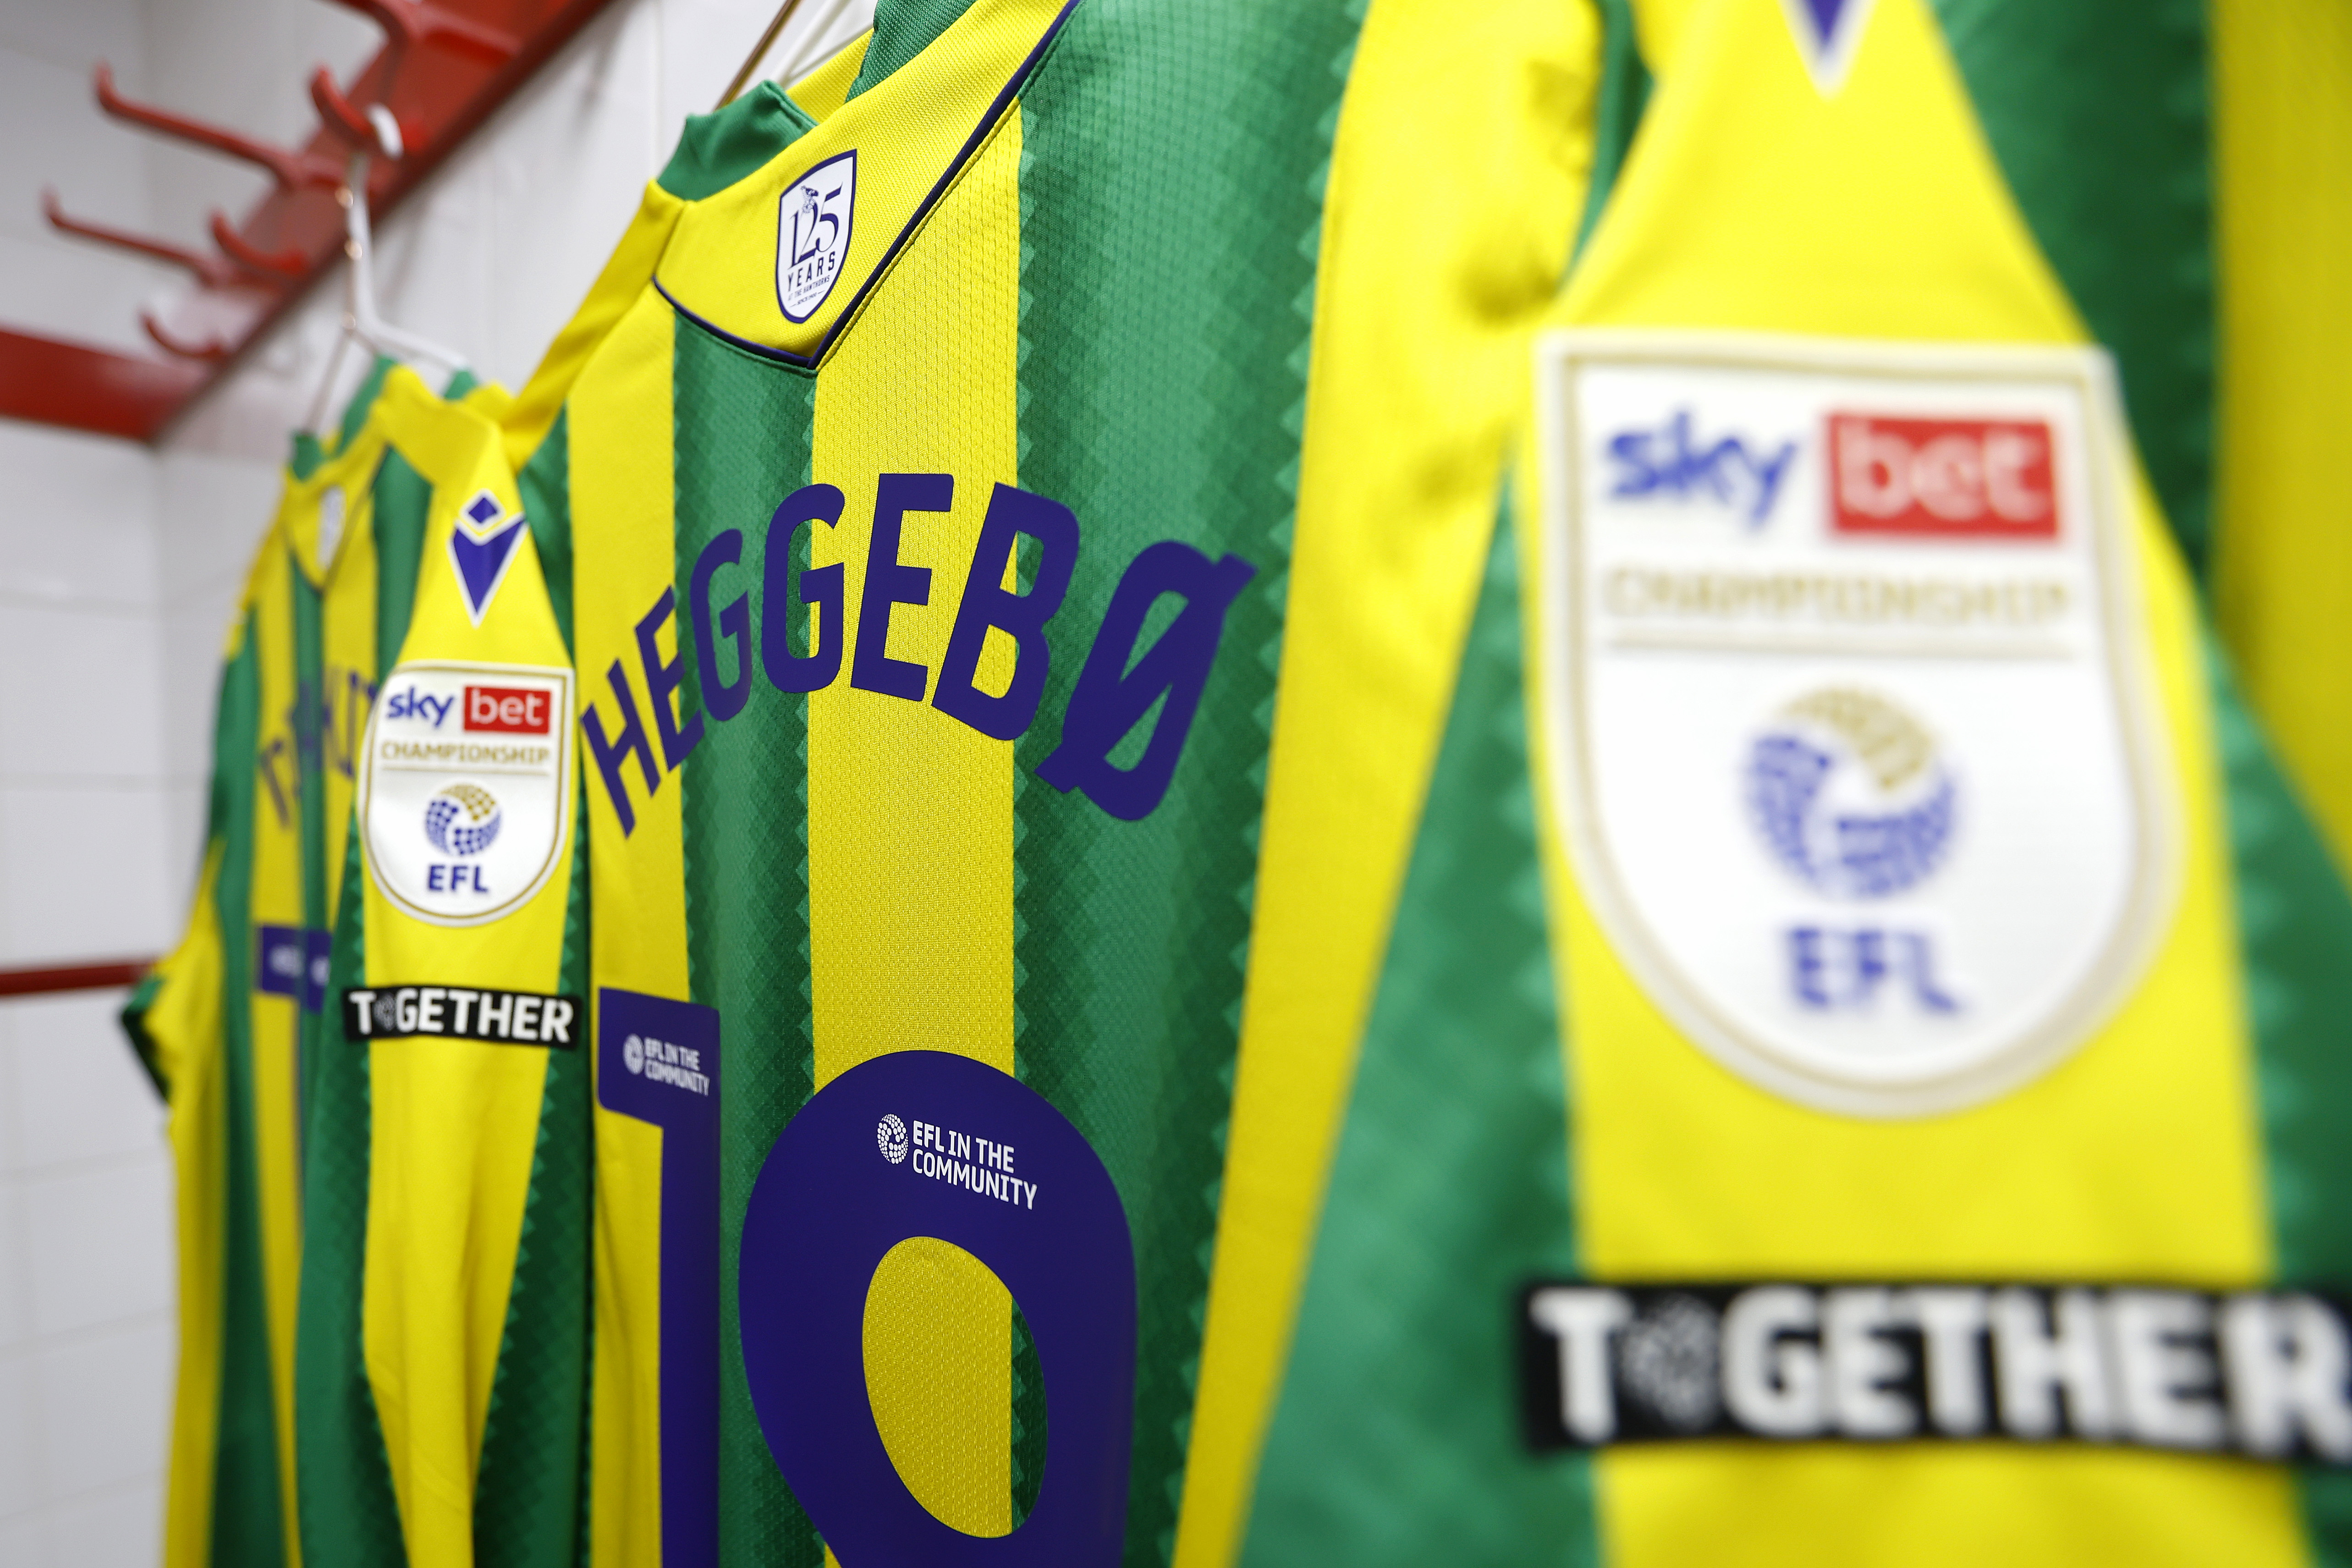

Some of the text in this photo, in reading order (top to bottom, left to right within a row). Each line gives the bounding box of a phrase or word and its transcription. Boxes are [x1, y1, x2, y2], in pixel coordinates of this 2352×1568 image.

[788, 182, 843, 270] 125
[787, 251, 836, 292] YEARS
[1605, 410, 2050, 532] sky bet
[580, 473, 1258, 840] HEGGEBØ
[386, 685, 544, 730] sky bet
[381, 740, 550, 765] CHAMPIONSHIP
[427, 864, 489, 894] EFL
[1787, 926, 1965, 1018] EFL
[644, 1059, 710, 1097] COMMUNITY
[680, 1045, 700, 1072] THE
[913, 1120, 1015, 1174] EFL IN THE
[913, 1149, 1038, 1210] COMMUNITY
